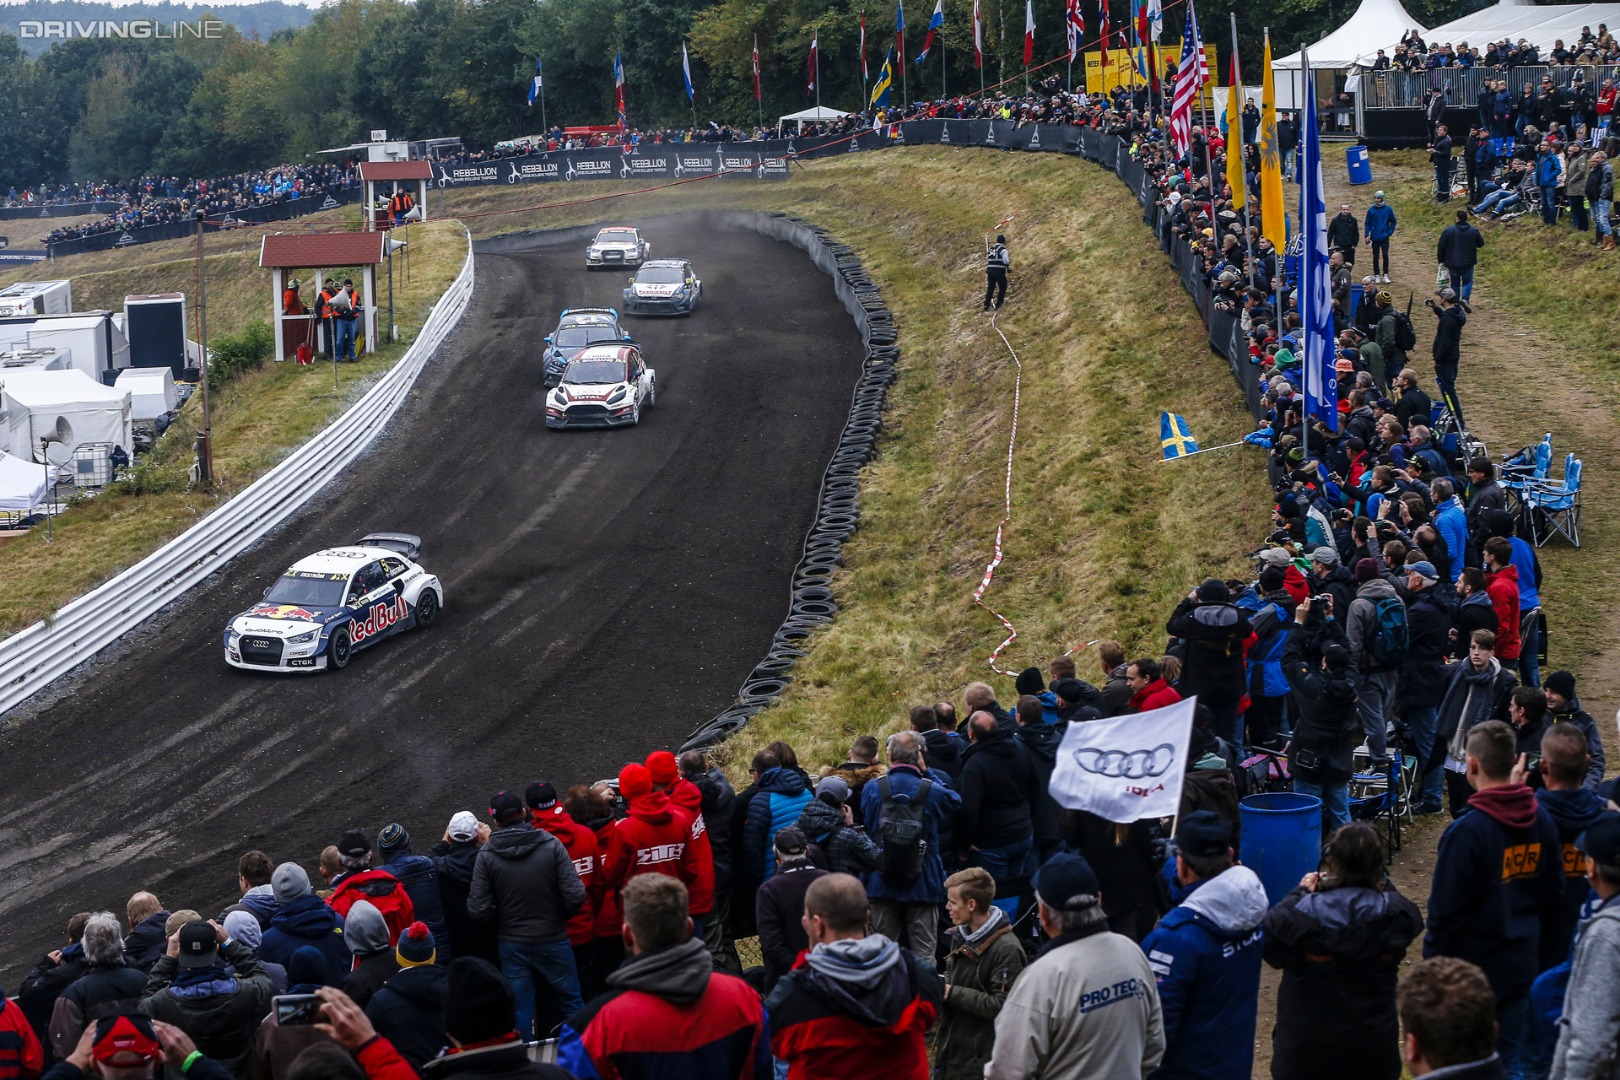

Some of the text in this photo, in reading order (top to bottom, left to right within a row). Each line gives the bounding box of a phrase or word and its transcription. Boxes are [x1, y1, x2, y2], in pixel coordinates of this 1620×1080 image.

[521, 163, 558, 174] REBELLION
[576, 161, 611, 170] REBELLION
[631, 158, 666, 168] REBELLION
[452, 167, 498, 178] REBELLION
[376, 593, 409, 632] Bull
[1079, 986, 1110, 1008] PRO
